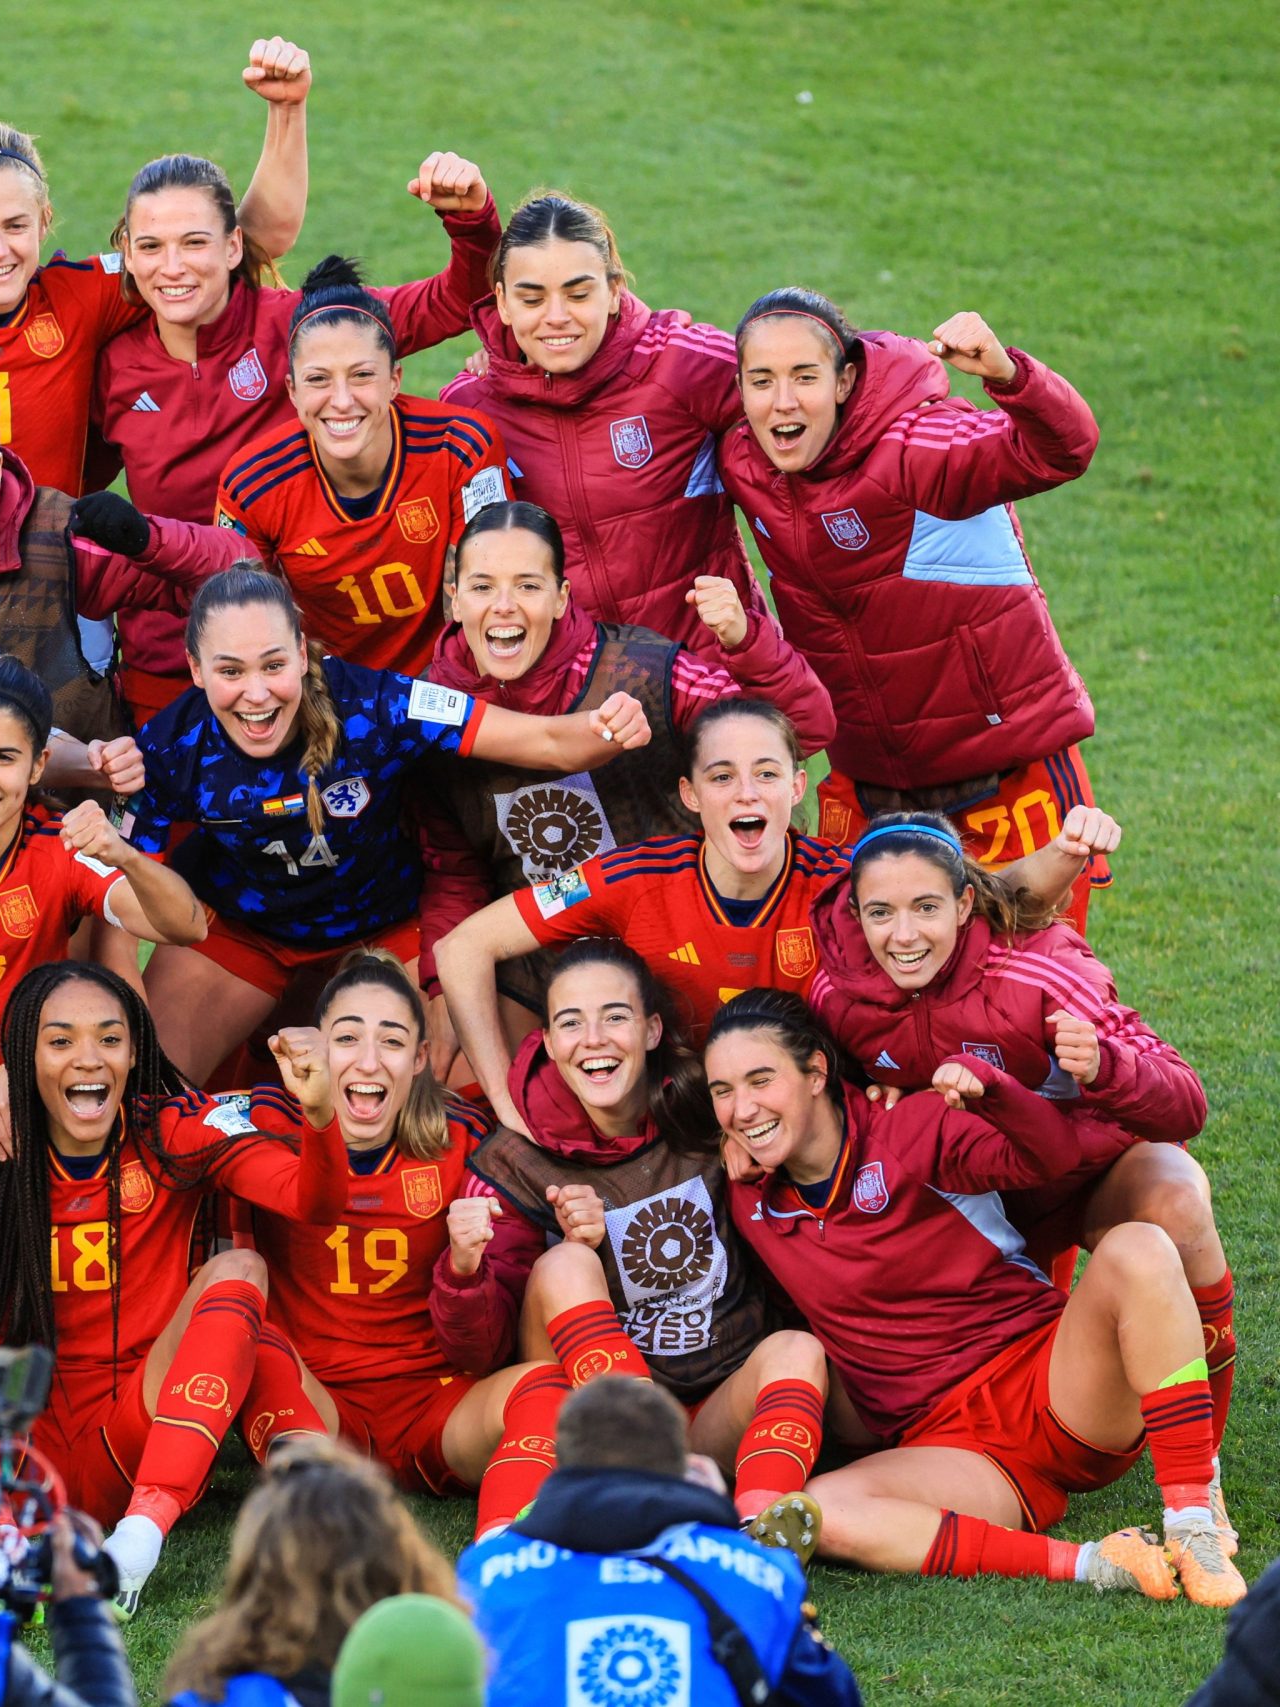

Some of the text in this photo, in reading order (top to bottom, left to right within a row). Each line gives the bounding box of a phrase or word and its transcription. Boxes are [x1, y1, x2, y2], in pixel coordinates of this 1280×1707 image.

[473, 481, 497, 498] UNITES
[335, 562, 426, 624] 10
[427, 688, 439, 710] UNITES
[261, 834, 340, 876] 14
[966, 789, 1061, 873] 20
[51, 1221, 117, 1292] 18
[324, 1224, 409, 1295] 19
